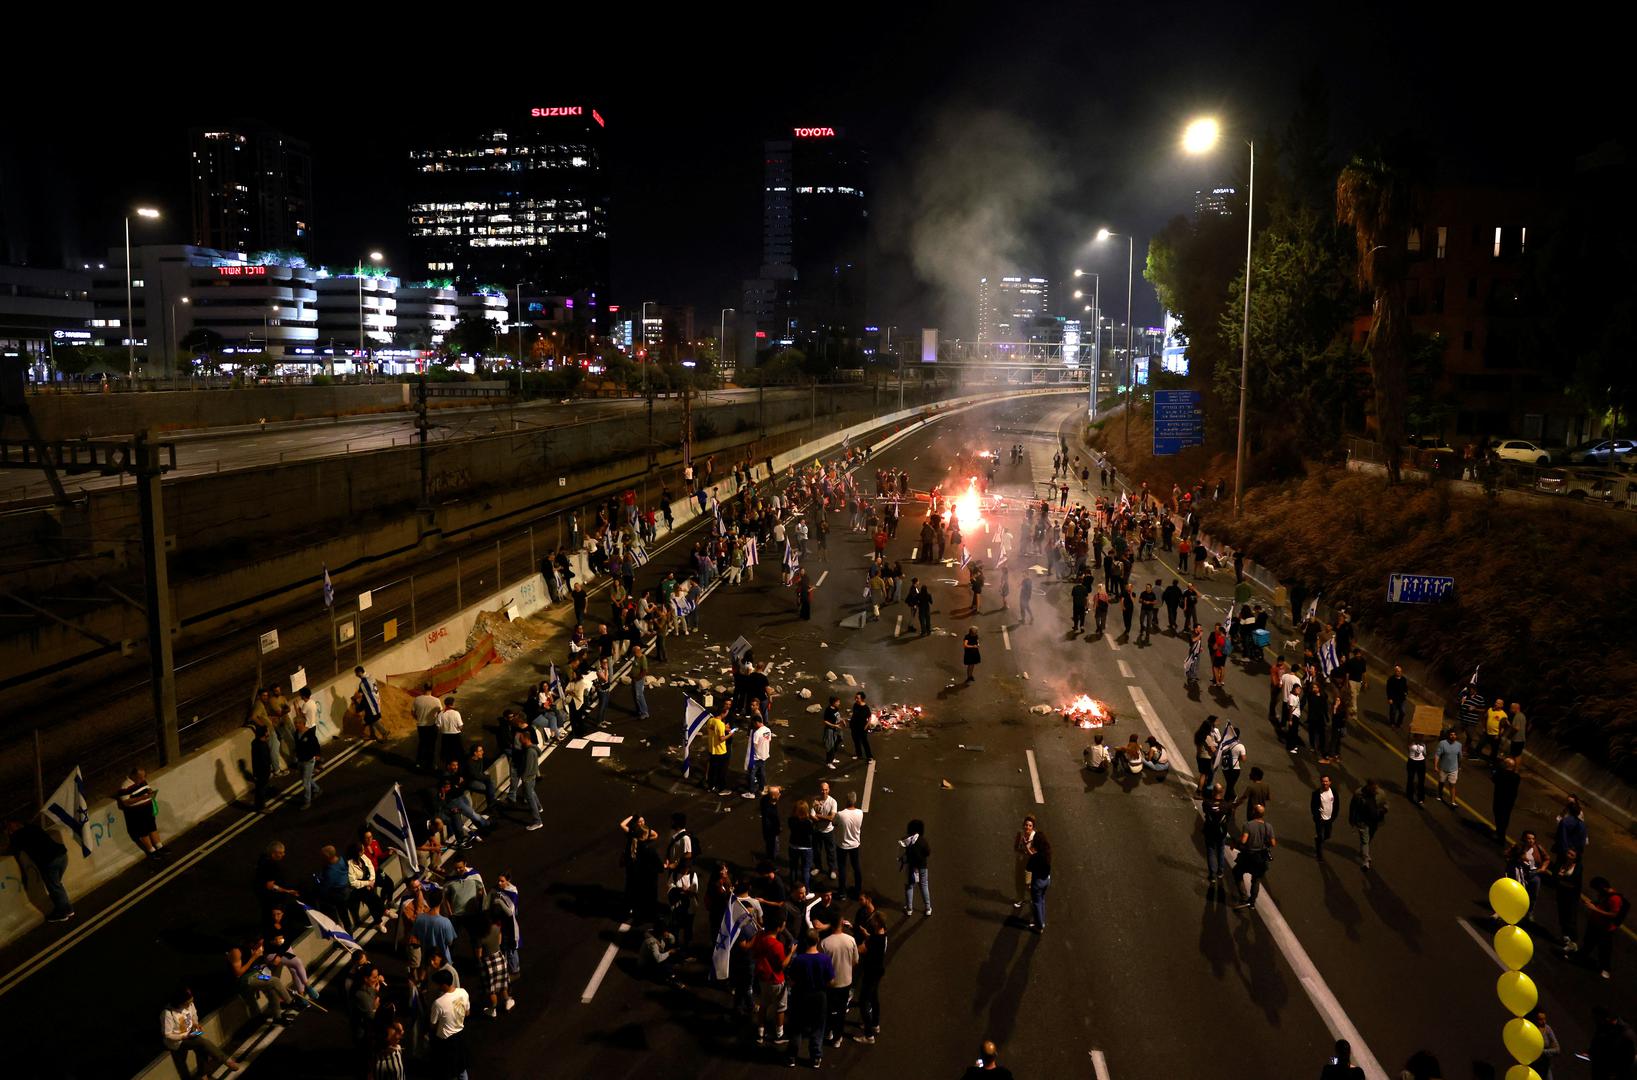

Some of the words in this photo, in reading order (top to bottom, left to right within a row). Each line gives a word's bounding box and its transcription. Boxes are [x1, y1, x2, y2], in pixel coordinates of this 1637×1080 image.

[531, 106, 582, 117] SUZUKI
[794, 127, 835, 137] TOYOTA
[244, 266, 265, 275] מרכז
